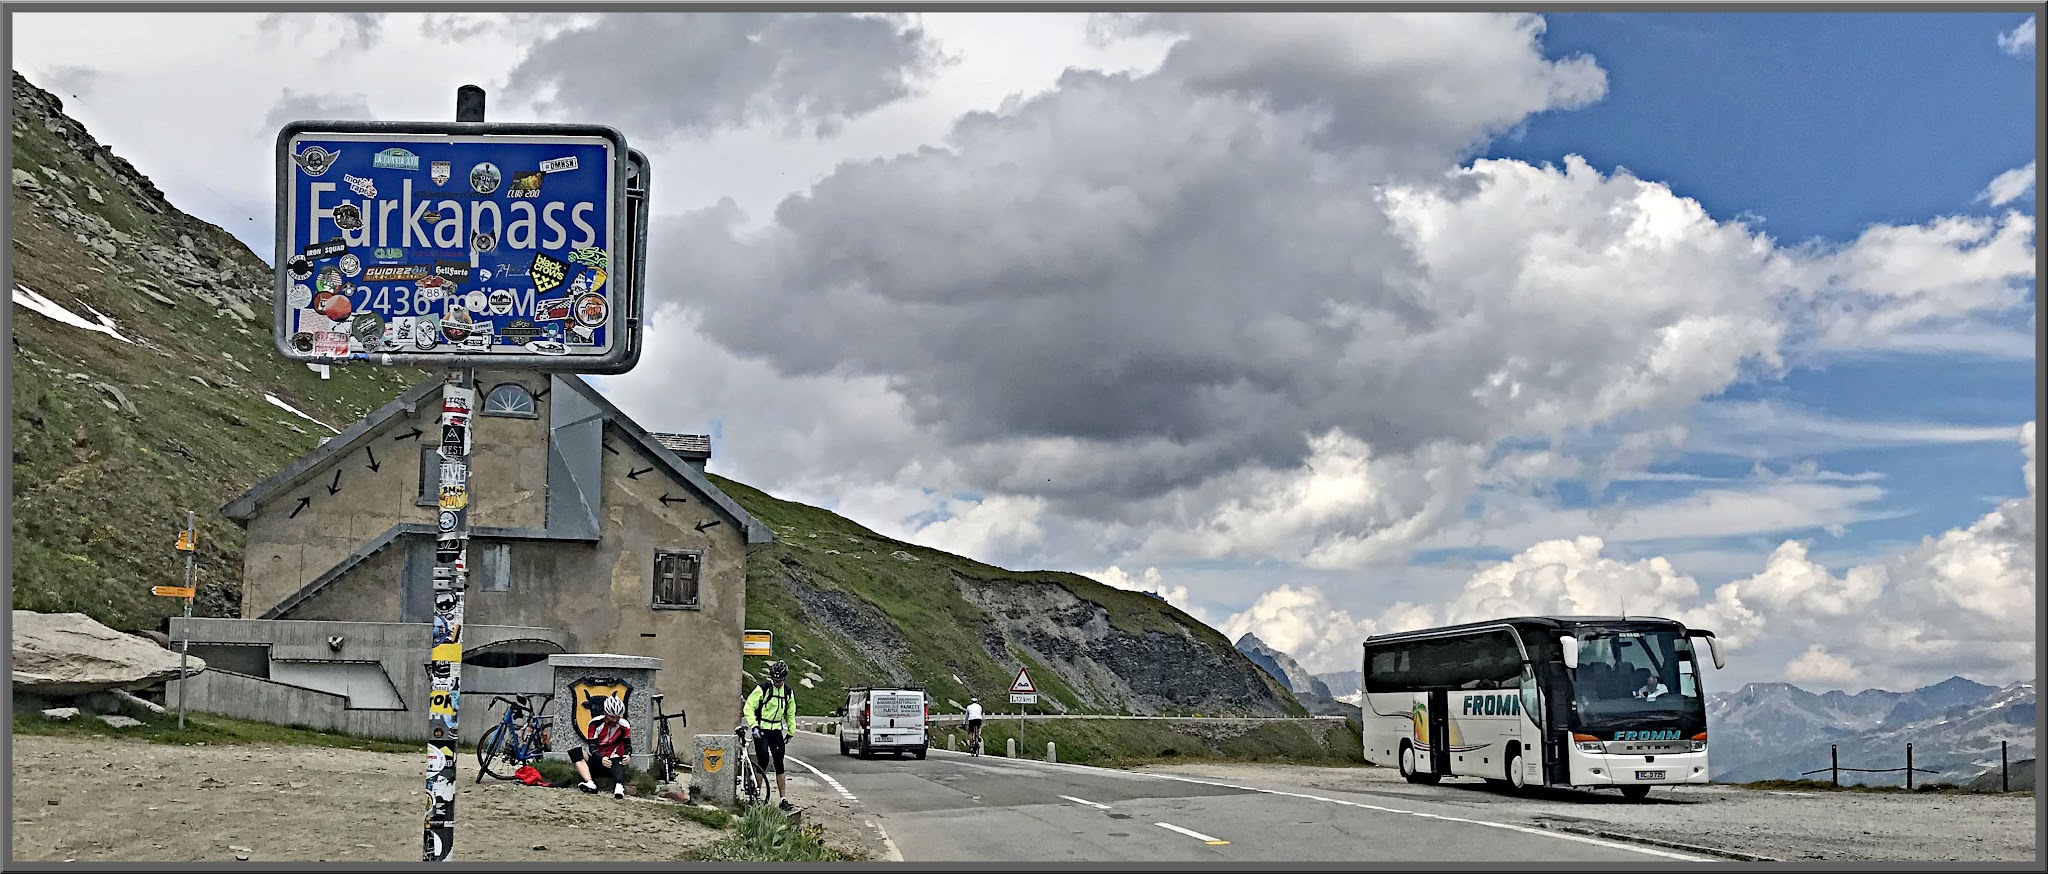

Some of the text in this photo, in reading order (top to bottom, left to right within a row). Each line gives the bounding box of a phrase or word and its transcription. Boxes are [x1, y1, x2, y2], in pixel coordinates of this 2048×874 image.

[524, 189, 540, 198] 200
[310, 178, 596, 268] Furkapass
[306, 244, 345, 257] IRON SQUAD
[536, 254, 562, 272] black
[533, 261, 565, 281] crows
[426, 288, 440, 298] 88
[356, 286, 430, 316] 2436
[1613, 730, 1682, 741] FROMM
